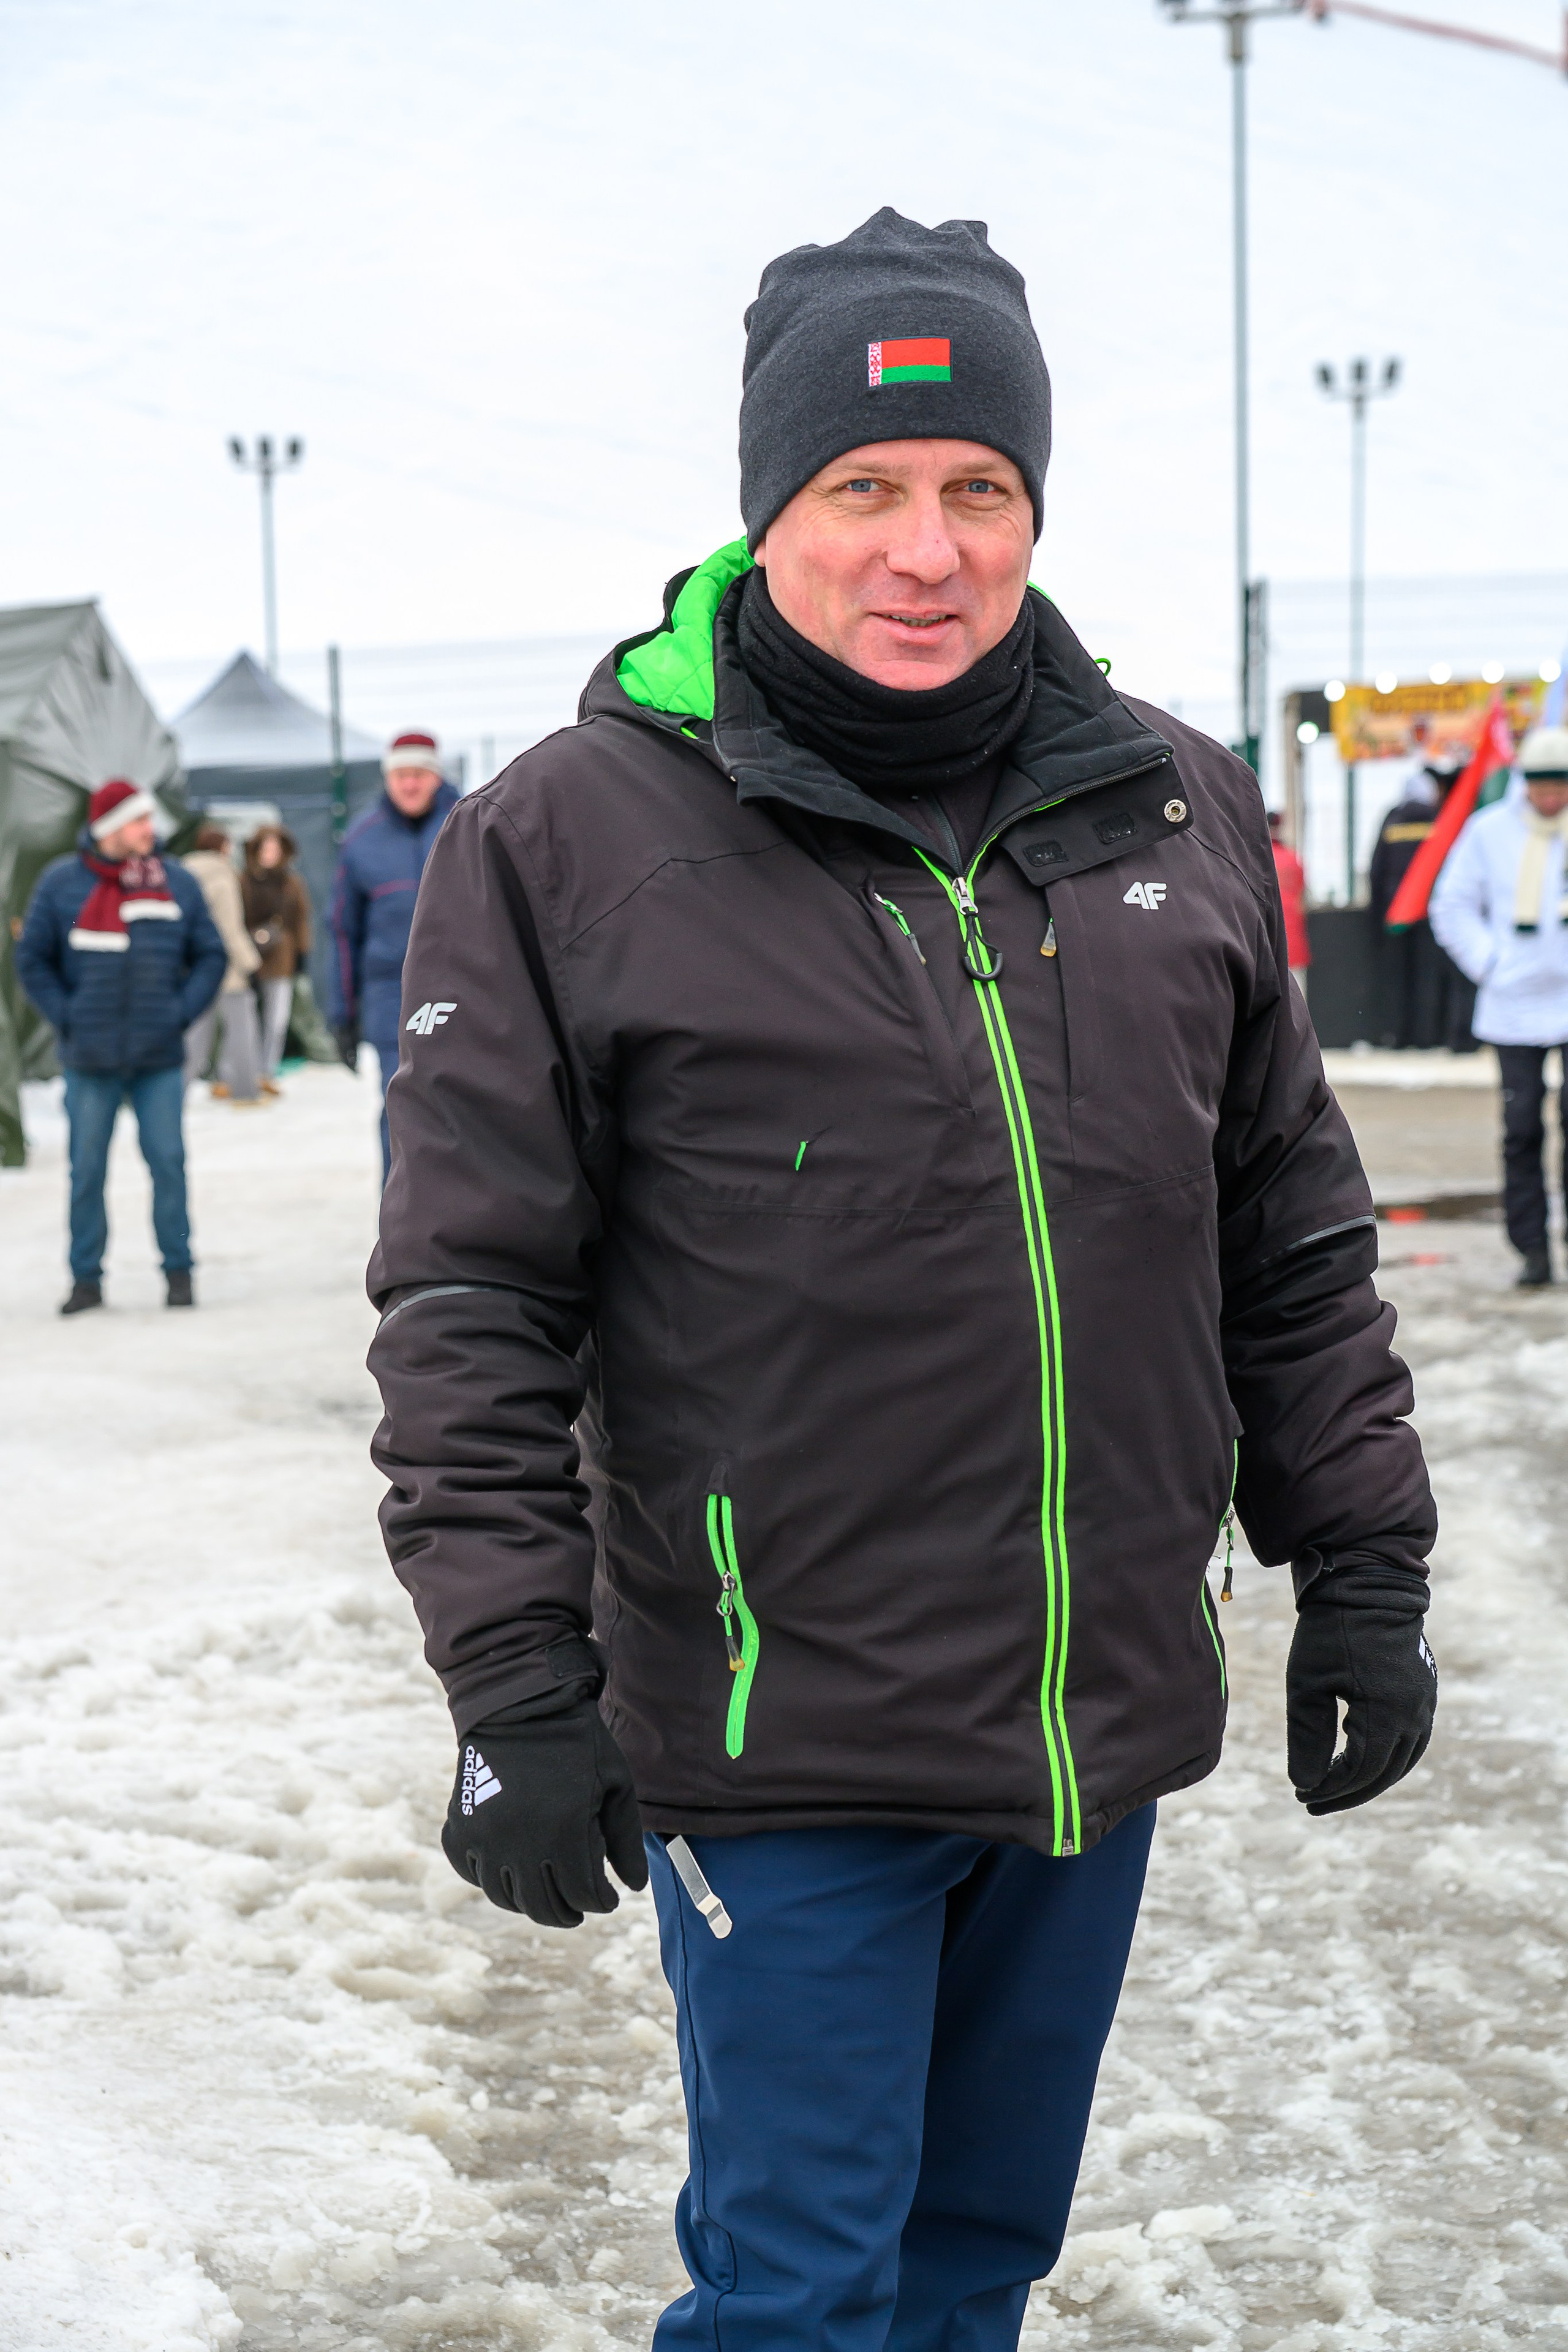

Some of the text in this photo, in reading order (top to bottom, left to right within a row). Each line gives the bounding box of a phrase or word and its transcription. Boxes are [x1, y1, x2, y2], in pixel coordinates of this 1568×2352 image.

[1123, 881, 1167, 910] 4F
[405, 1002, 458, 1035] 4F
[461, 1745, 478, 1816] adidas
